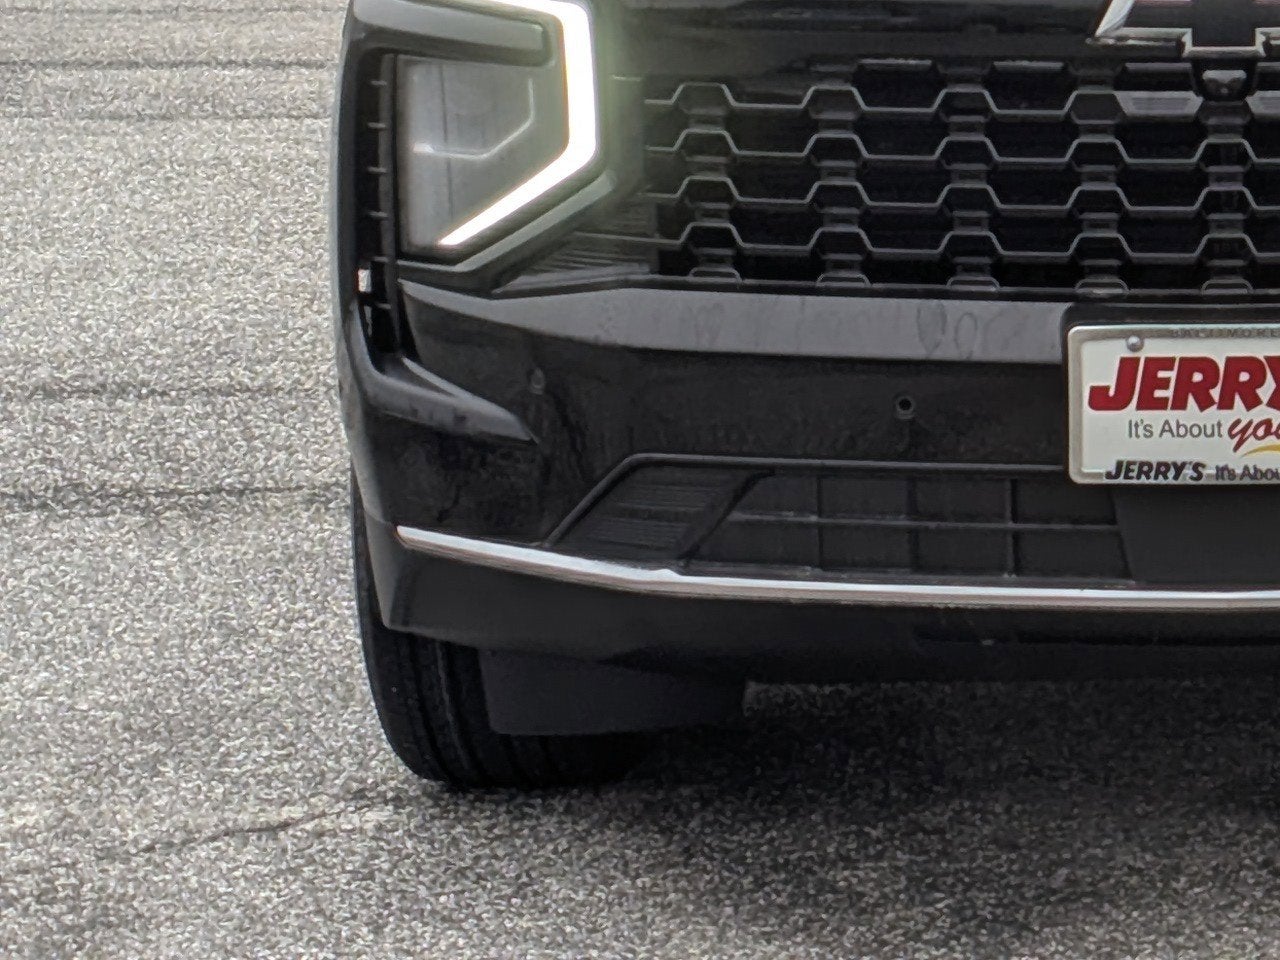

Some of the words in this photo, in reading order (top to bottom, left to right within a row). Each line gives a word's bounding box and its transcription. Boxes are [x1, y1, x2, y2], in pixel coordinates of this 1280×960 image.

[1127, 419, 1154, 439] It's
[1159, 418, 1223, 439] About
[1104, 460, 1206, 481] JERRY'S
[1214, 464, 1236, 481] It's
